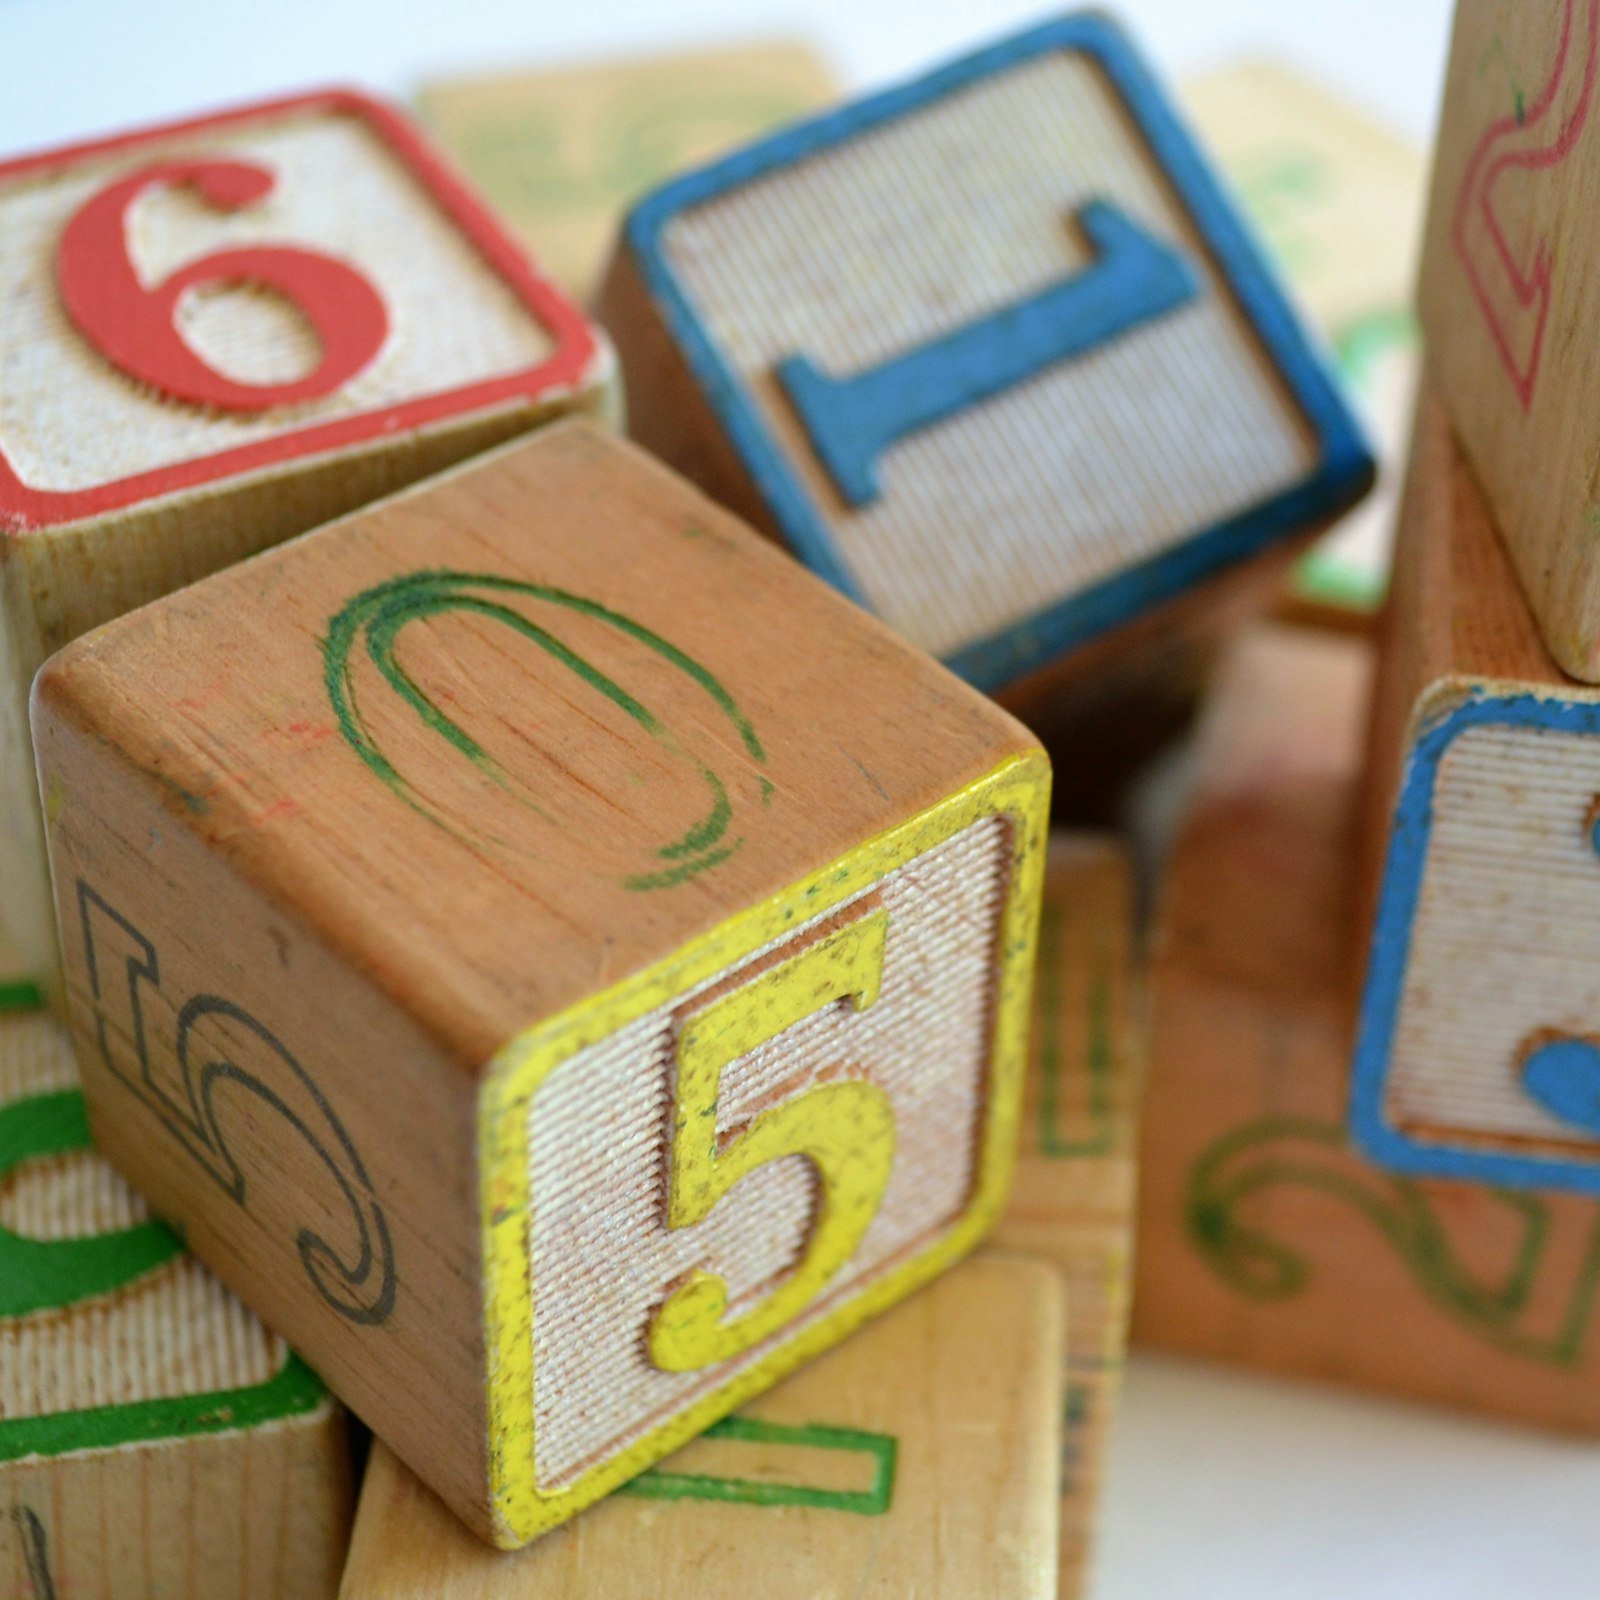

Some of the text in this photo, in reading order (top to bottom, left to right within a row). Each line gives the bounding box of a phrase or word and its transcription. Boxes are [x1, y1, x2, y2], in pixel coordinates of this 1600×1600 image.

[57, 157, 391, 413] 6
[778, 193, 1202, 510] 1
[77, 878, 396, 1326] 5
[648, 906, 895, 1374] 5
